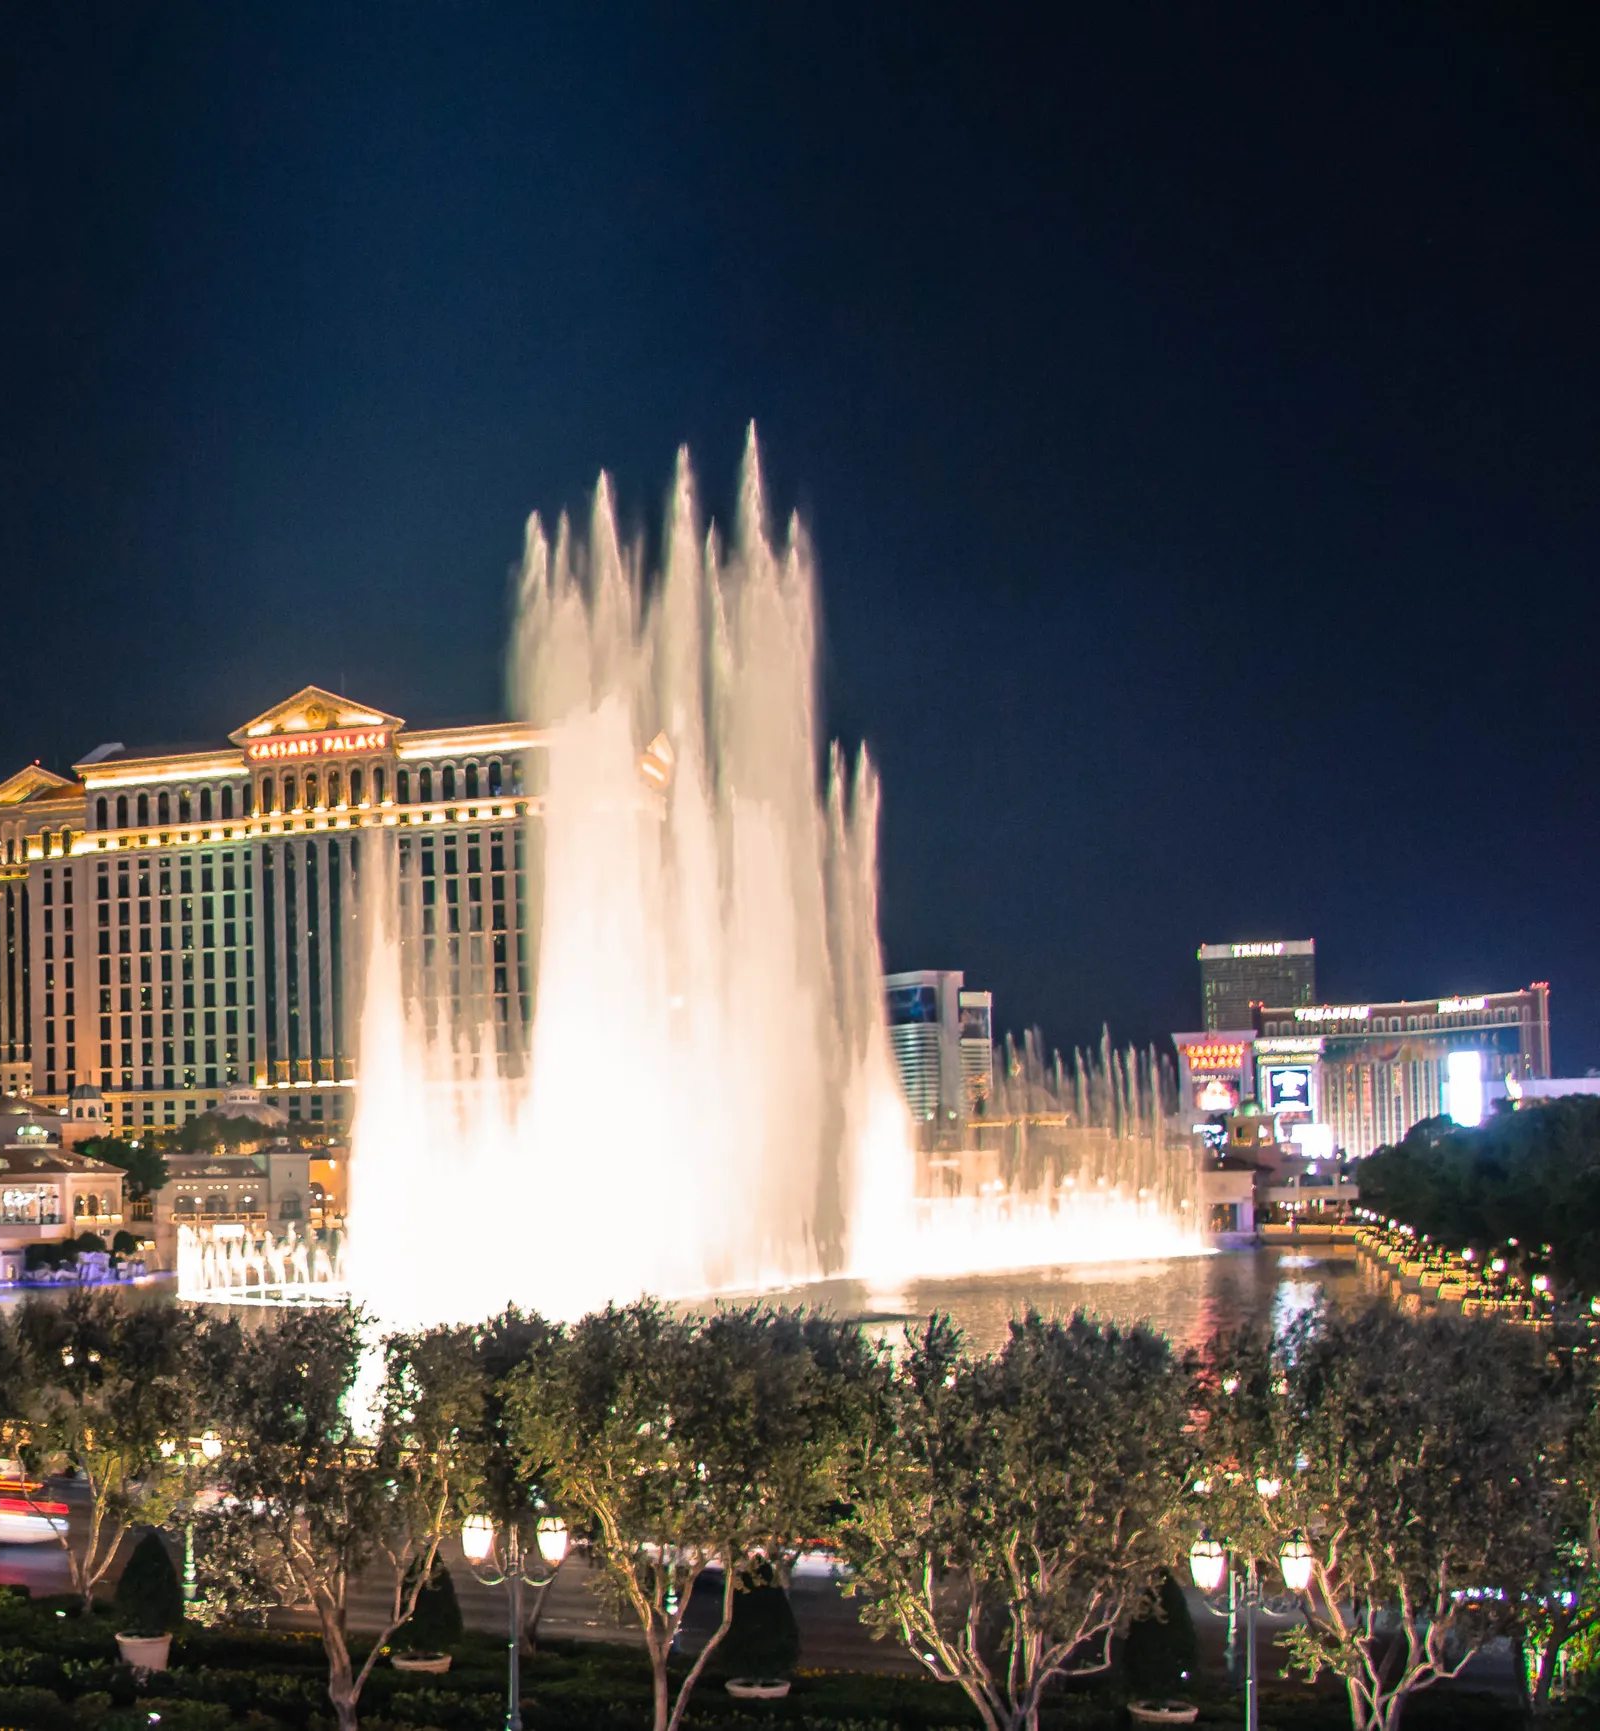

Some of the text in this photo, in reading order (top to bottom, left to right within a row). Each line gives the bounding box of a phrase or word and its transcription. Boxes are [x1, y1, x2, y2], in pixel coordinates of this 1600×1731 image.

[248, 732, 386, 760] CAESARS PALACE
[1231, 942, 1285, 958] TRUMP
[1187, 1043, 1244, 1057] CAESARS
[1189, 1055, 1242, 1069] PALACE
